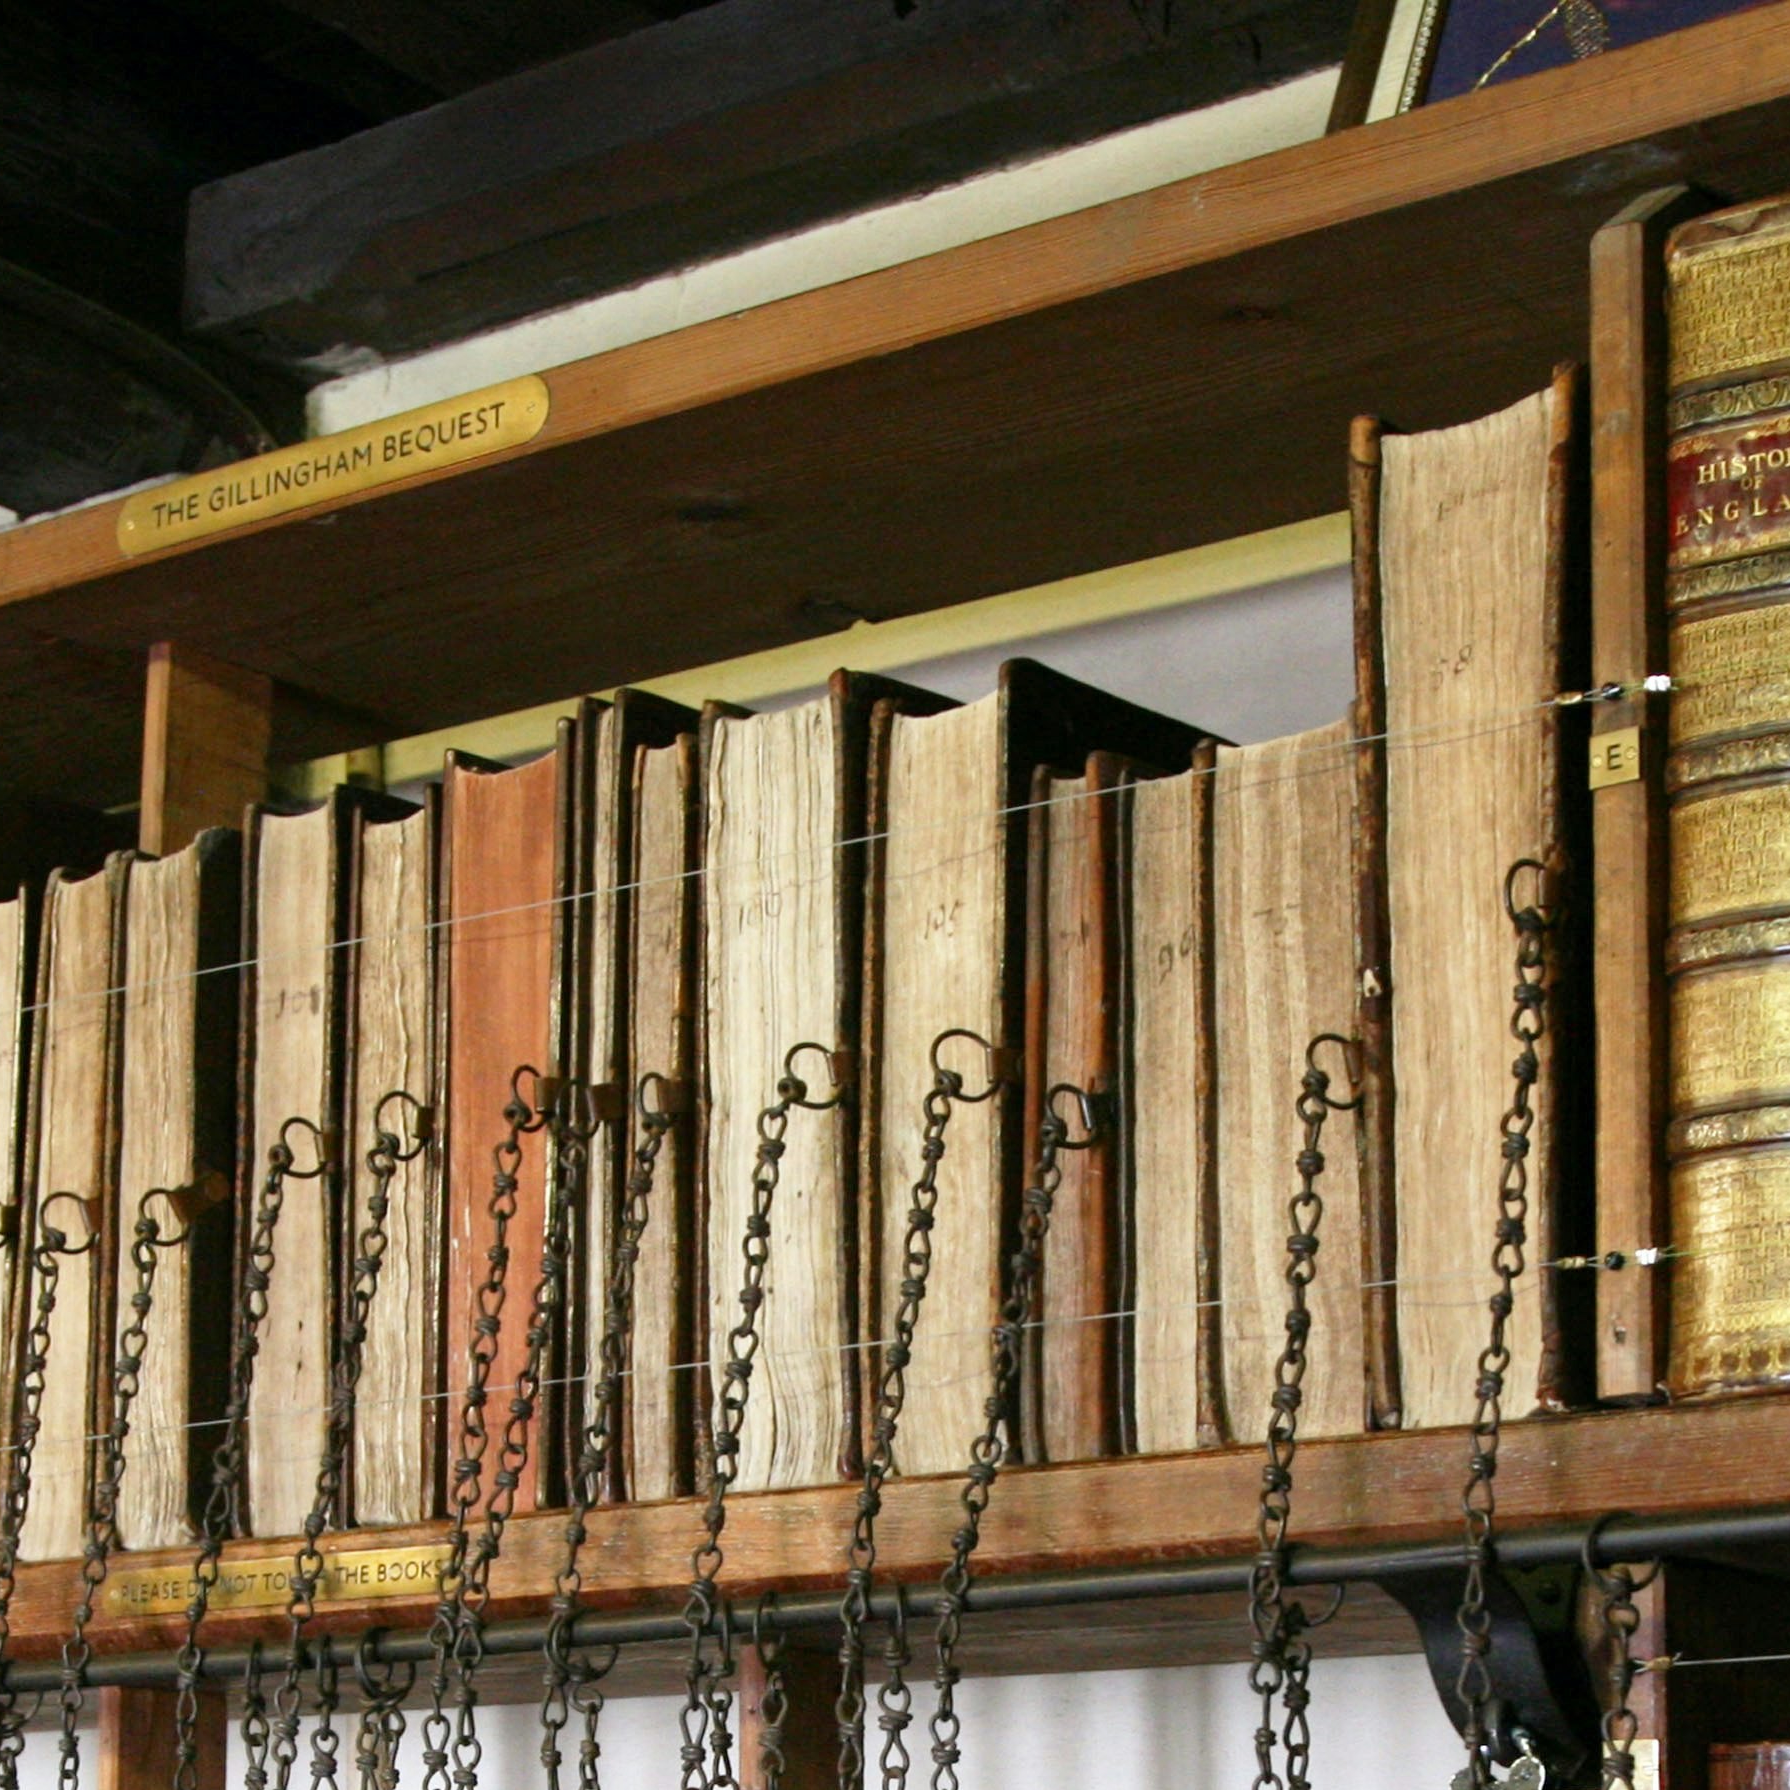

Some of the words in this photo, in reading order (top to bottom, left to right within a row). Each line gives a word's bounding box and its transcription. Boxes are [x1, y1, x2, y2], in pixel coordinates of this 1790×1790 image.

[153, 495, 200, 529] THE
[210, 445, 372, 513] GILLINGHAM
[382, 403, 506, 462] BEQUEST
[1605, 743, 1622, 771] E
[121, 1580, 181, 1604] PLEASE
[334, 1565, 371, 1586] THE
[377, 1558, 445, 1582] BOOKS
